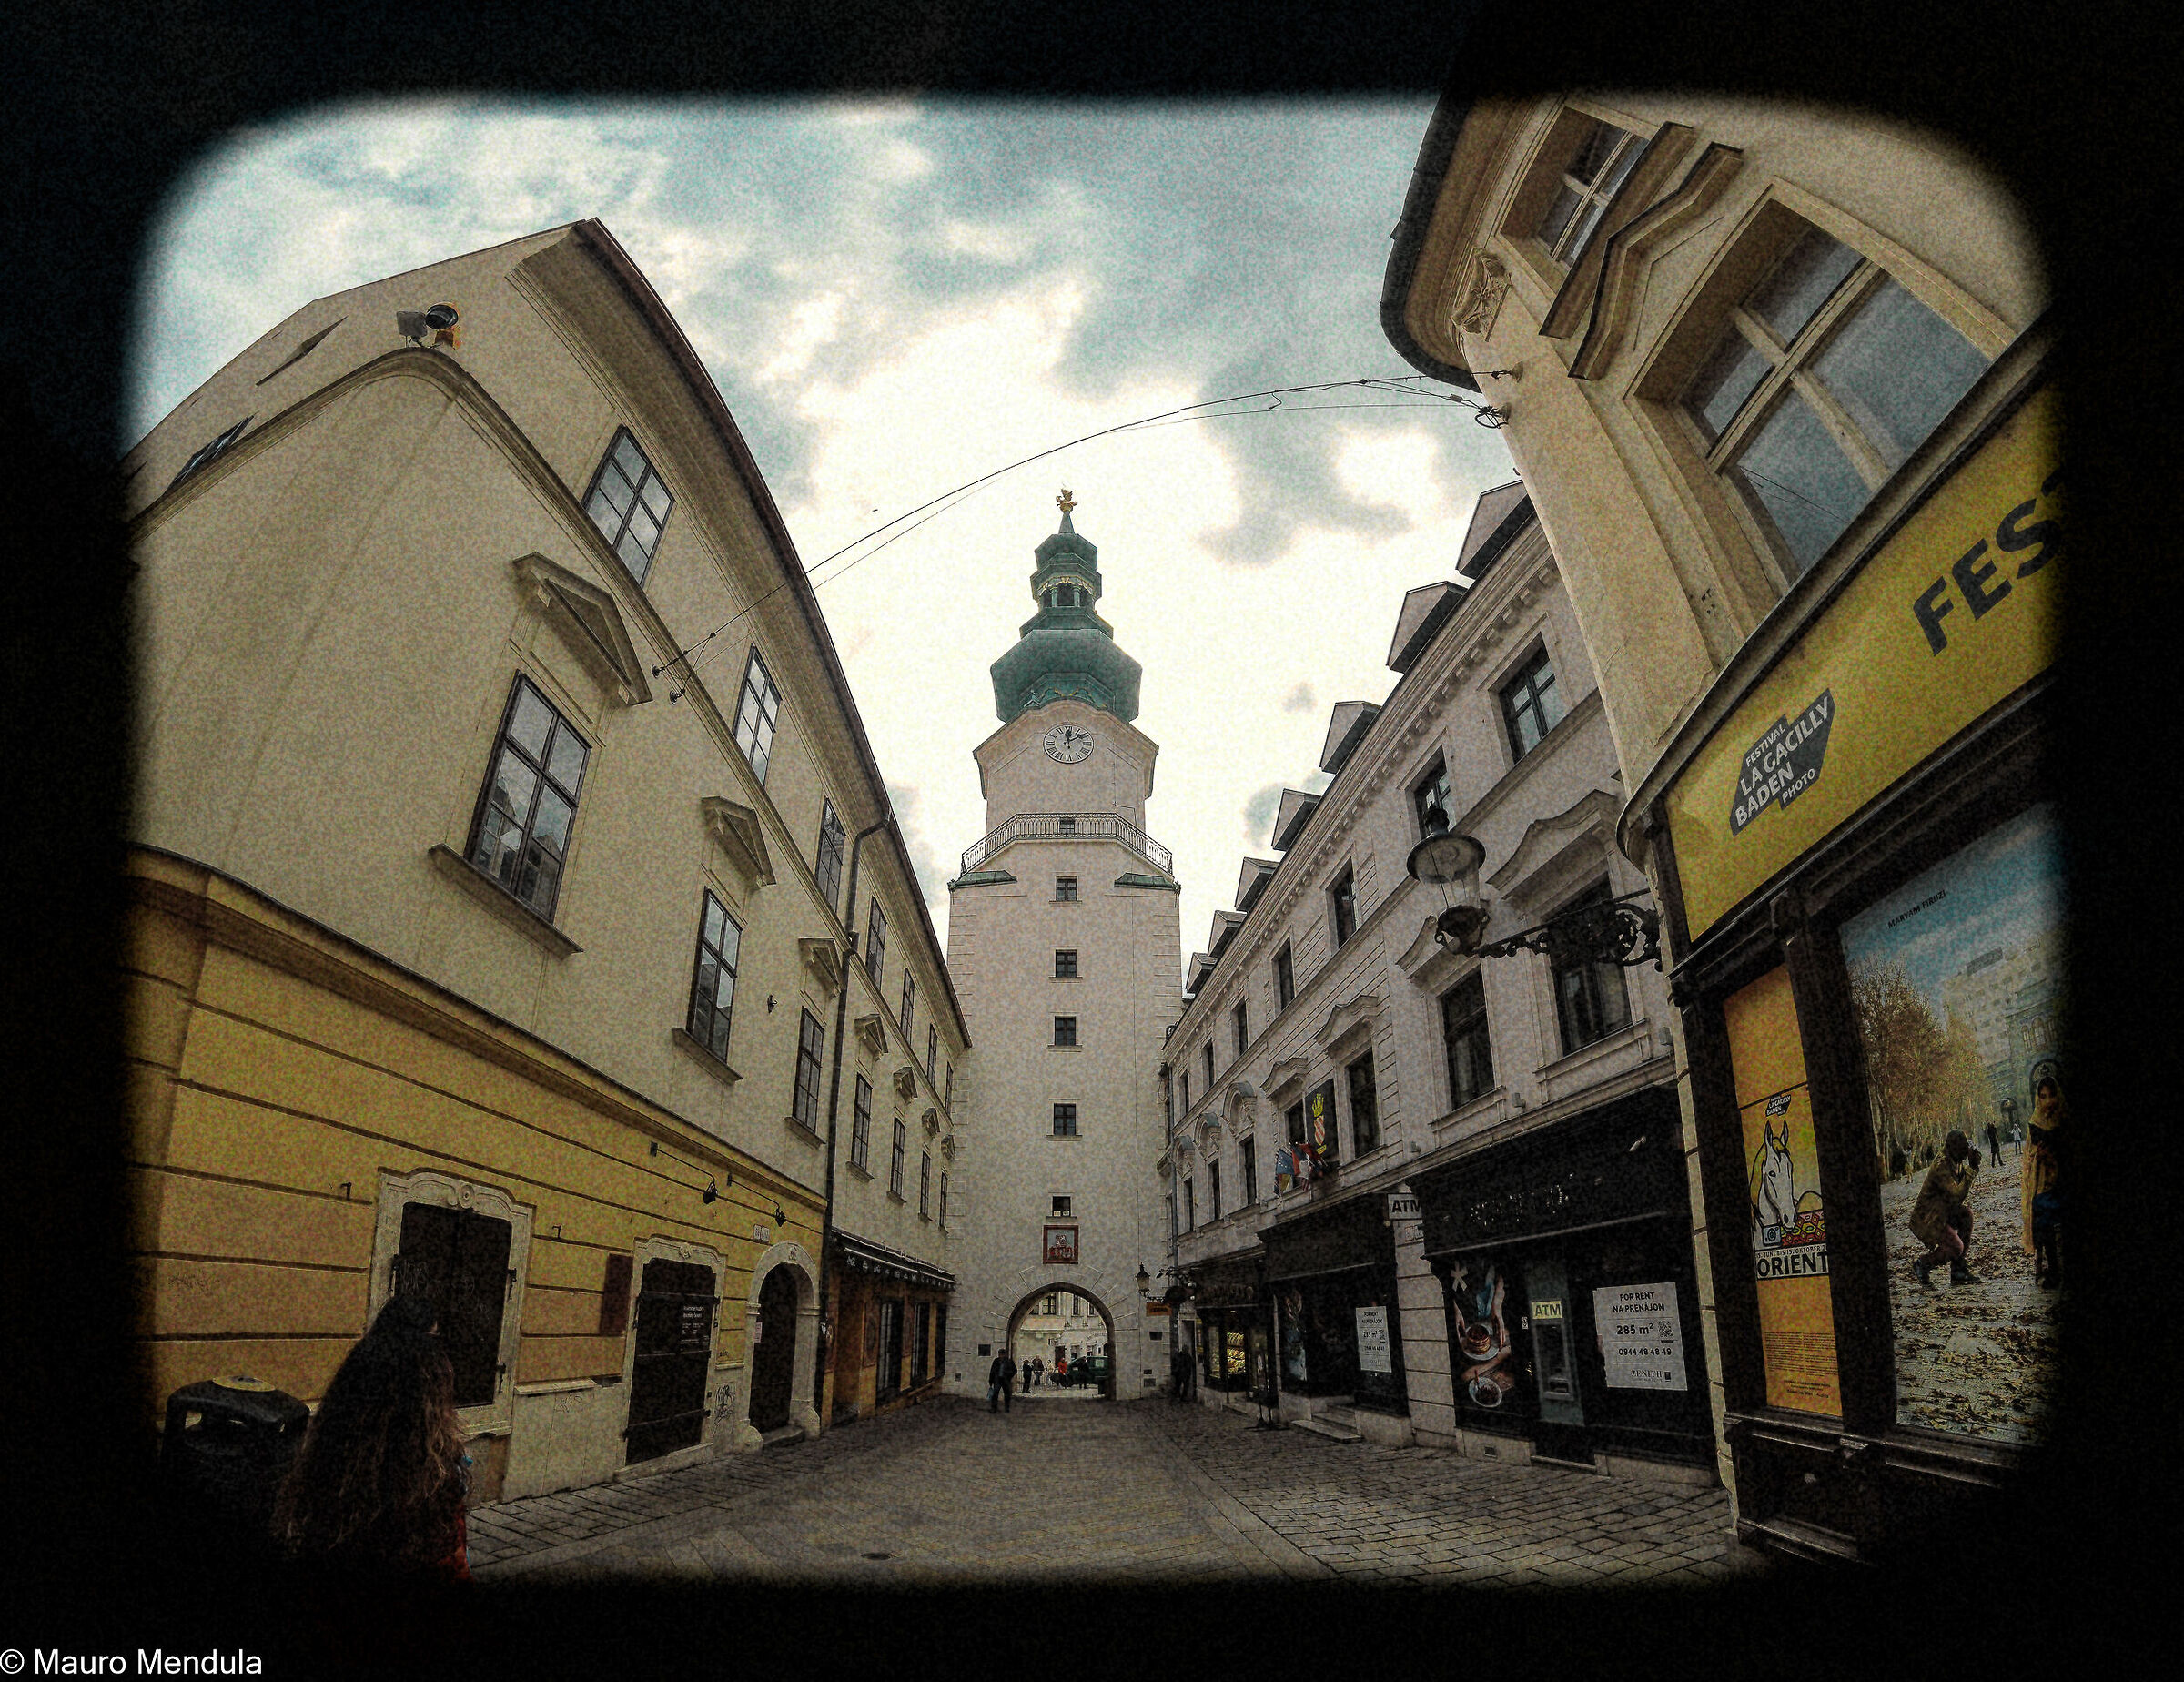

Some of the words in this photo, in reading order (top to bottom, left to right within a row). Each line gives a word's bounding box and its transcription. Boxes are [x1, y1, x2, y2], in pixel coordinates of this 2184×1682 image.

[1740, 766, 1764, 796] LA
[1763, 696, 1830, 774] GACILLY
[1745, 724, 1786, 767] FESTIVAL
[1734, 761, 1795, 827] BADEN
[1781, 767, 1816, 804] PHOTO
[1887, 905, 1921, 928] MARYAM
[1757, 1251, 1827, 1277] ORIENT
[1613, 1304, 1624, 1313] NA
[1624, 1302, 1665, 1312] PRENÁJOM
[1619, 1292, 1634, 1302] FOR
[1635, 1292, 1655, 1301] RENT
[1535, 1303, 1561, 1316] ATM
[1616, 1324, 1636, 1335] 285
[1618, 1348, 1638, 1356] 0944
[1639, 1348, 1649, 1356] 48
[1650, 1348, 1661, 1356] 48
[1662, 1348, 1673, 1356] 49
